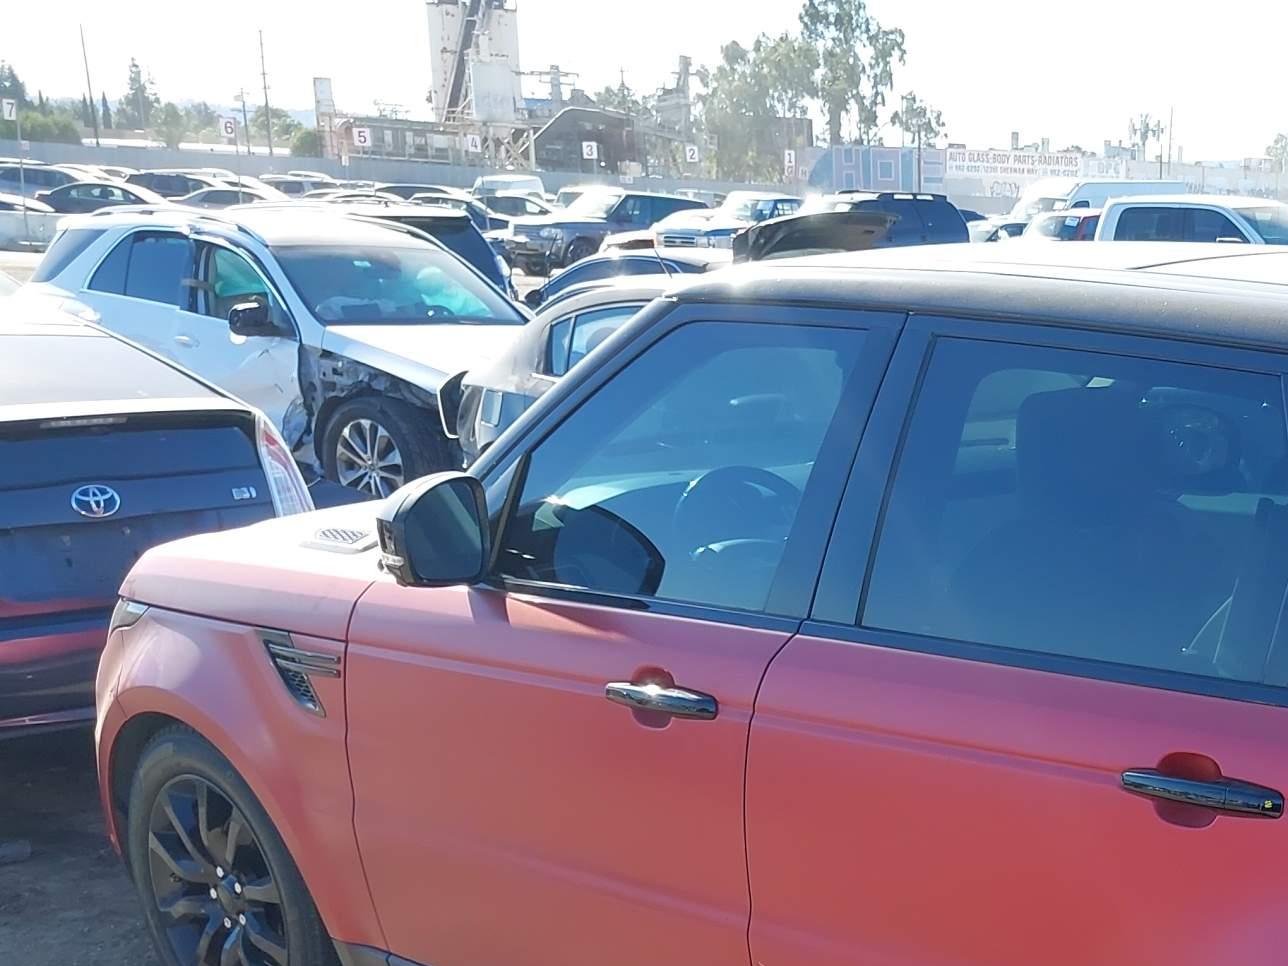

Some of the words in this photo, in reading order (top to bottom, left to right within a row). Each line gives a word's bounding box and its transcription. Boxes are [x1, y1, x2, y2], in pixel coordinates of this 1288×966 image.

[6, 102, 14, 118] 7
[224, 121, 234, 135] 6
[357, 131, 367, 145] 5
[949, 151, 966, 163] AUTO
